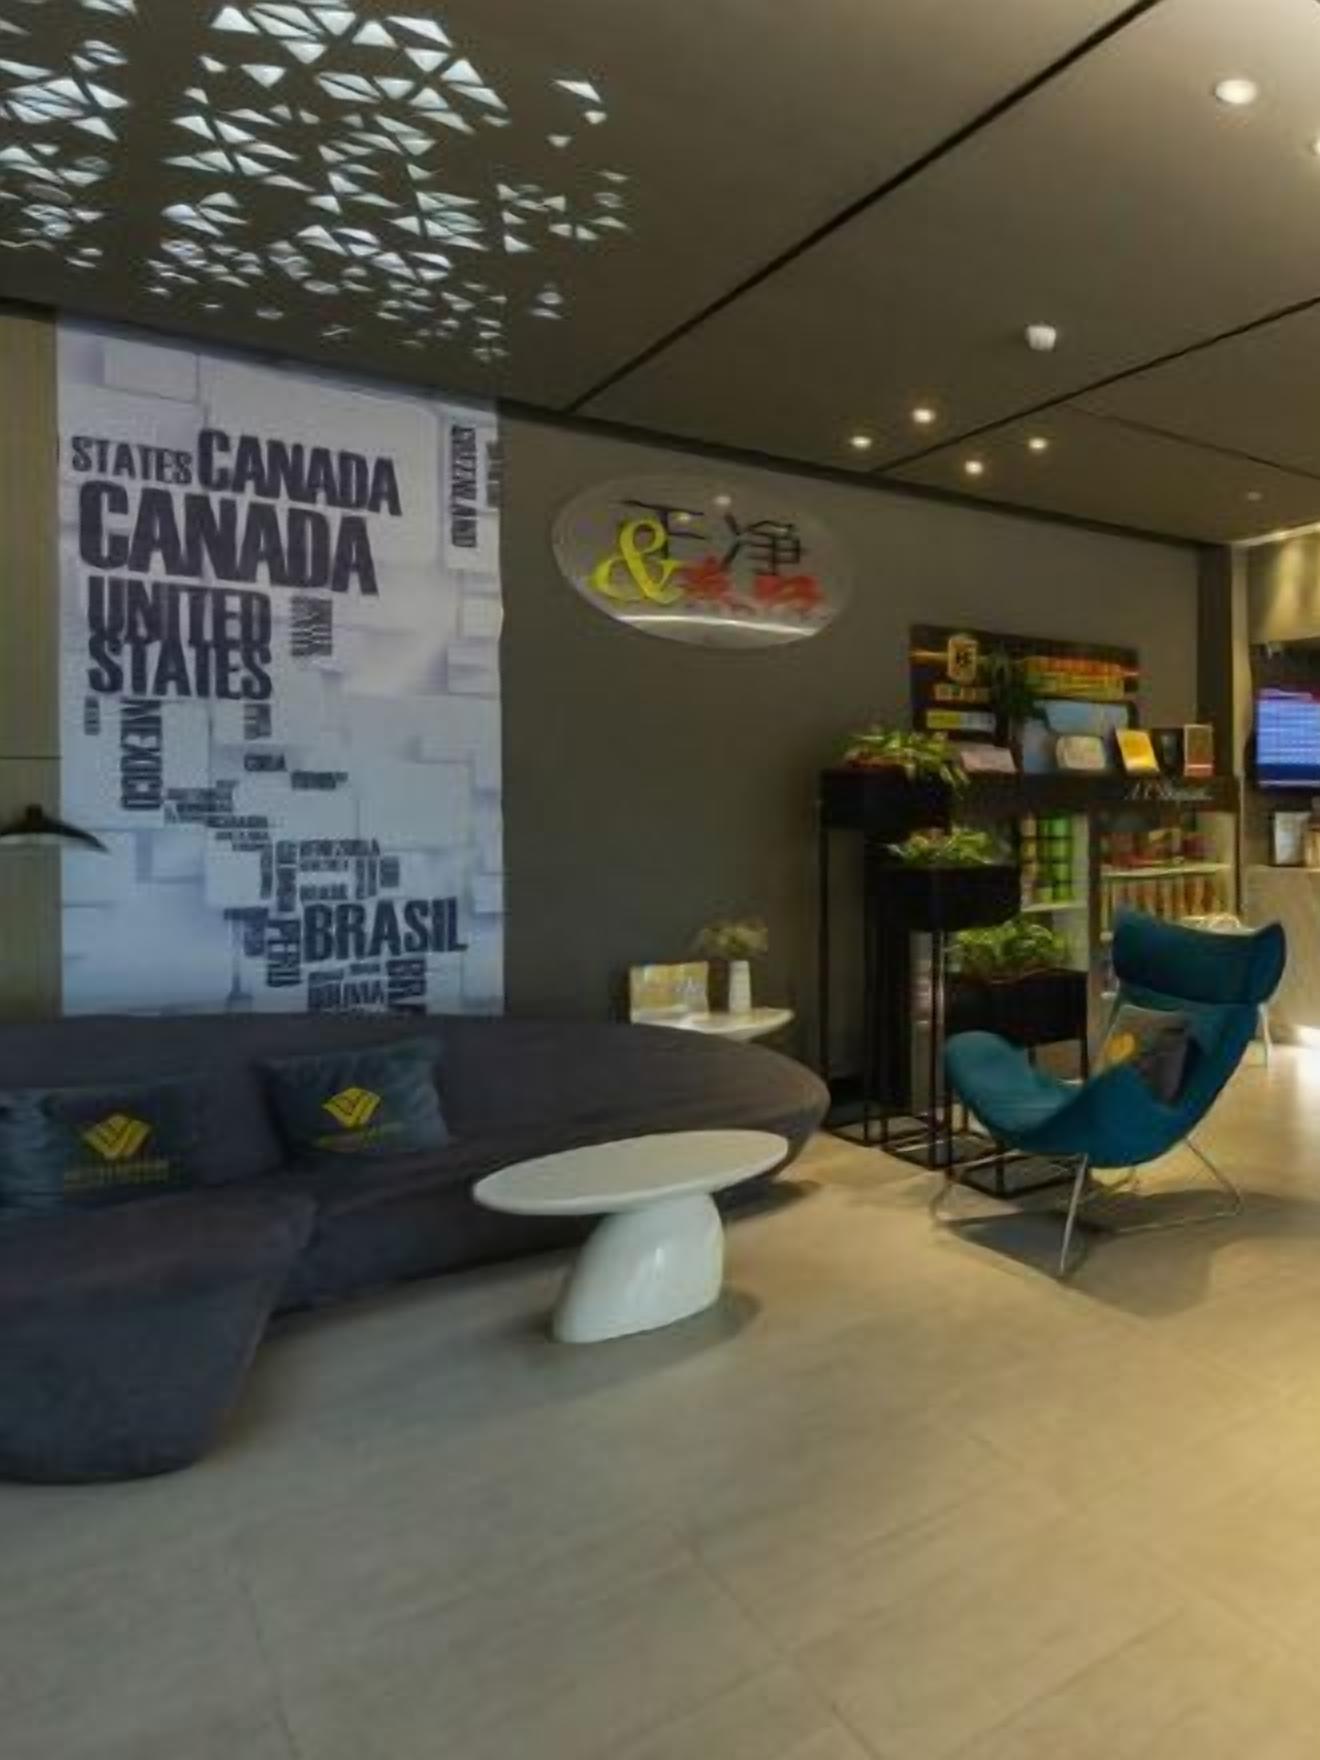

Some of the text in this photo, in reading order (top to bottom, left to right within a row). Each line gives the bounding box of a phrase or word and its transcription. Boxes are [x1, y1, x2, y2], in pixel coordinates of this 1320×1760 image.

[72, 436, 193, 485] STATES
[198, 428, 403, 516] CANADA
[79, 481, 378, 595] CANADA
[88, 576, 272, 648] UNITED
[88, 634, 273, 700] STATES
[120, 698, 163, 811] MEXICO
[267, 918, 302, 988] PERU
[303, 896, 468, 962] BRASIL
